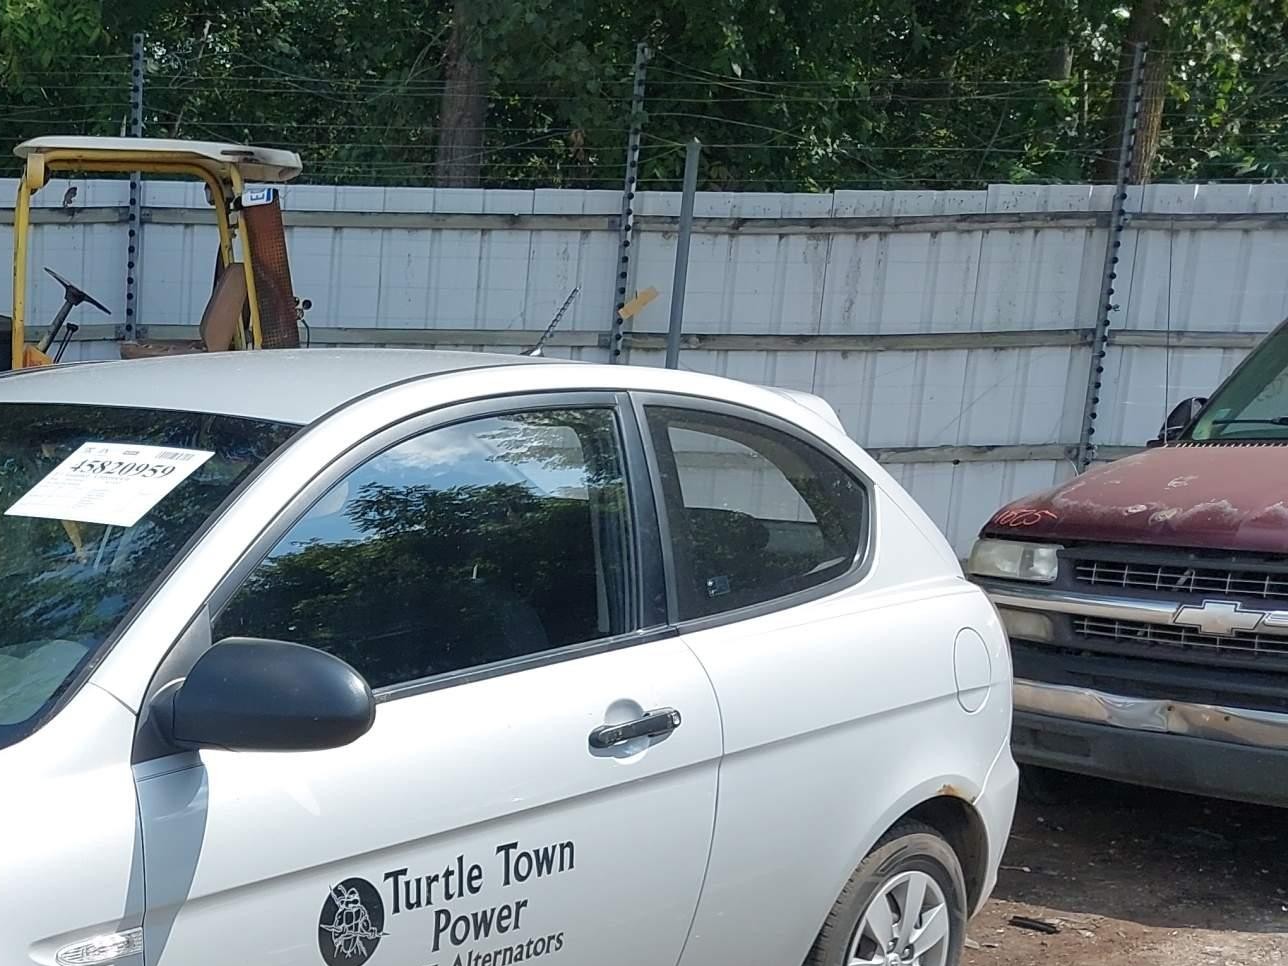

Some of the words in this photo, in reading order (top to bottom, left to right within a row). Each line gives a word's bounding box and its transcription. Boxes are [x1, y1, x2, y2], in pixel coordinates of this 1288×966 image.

[70, 459, 176, 478] 45820959
[383, 854, 483, 915] Turtle
[495, 839, 575, 887] Town
[431, 898, 529, 952] Power
